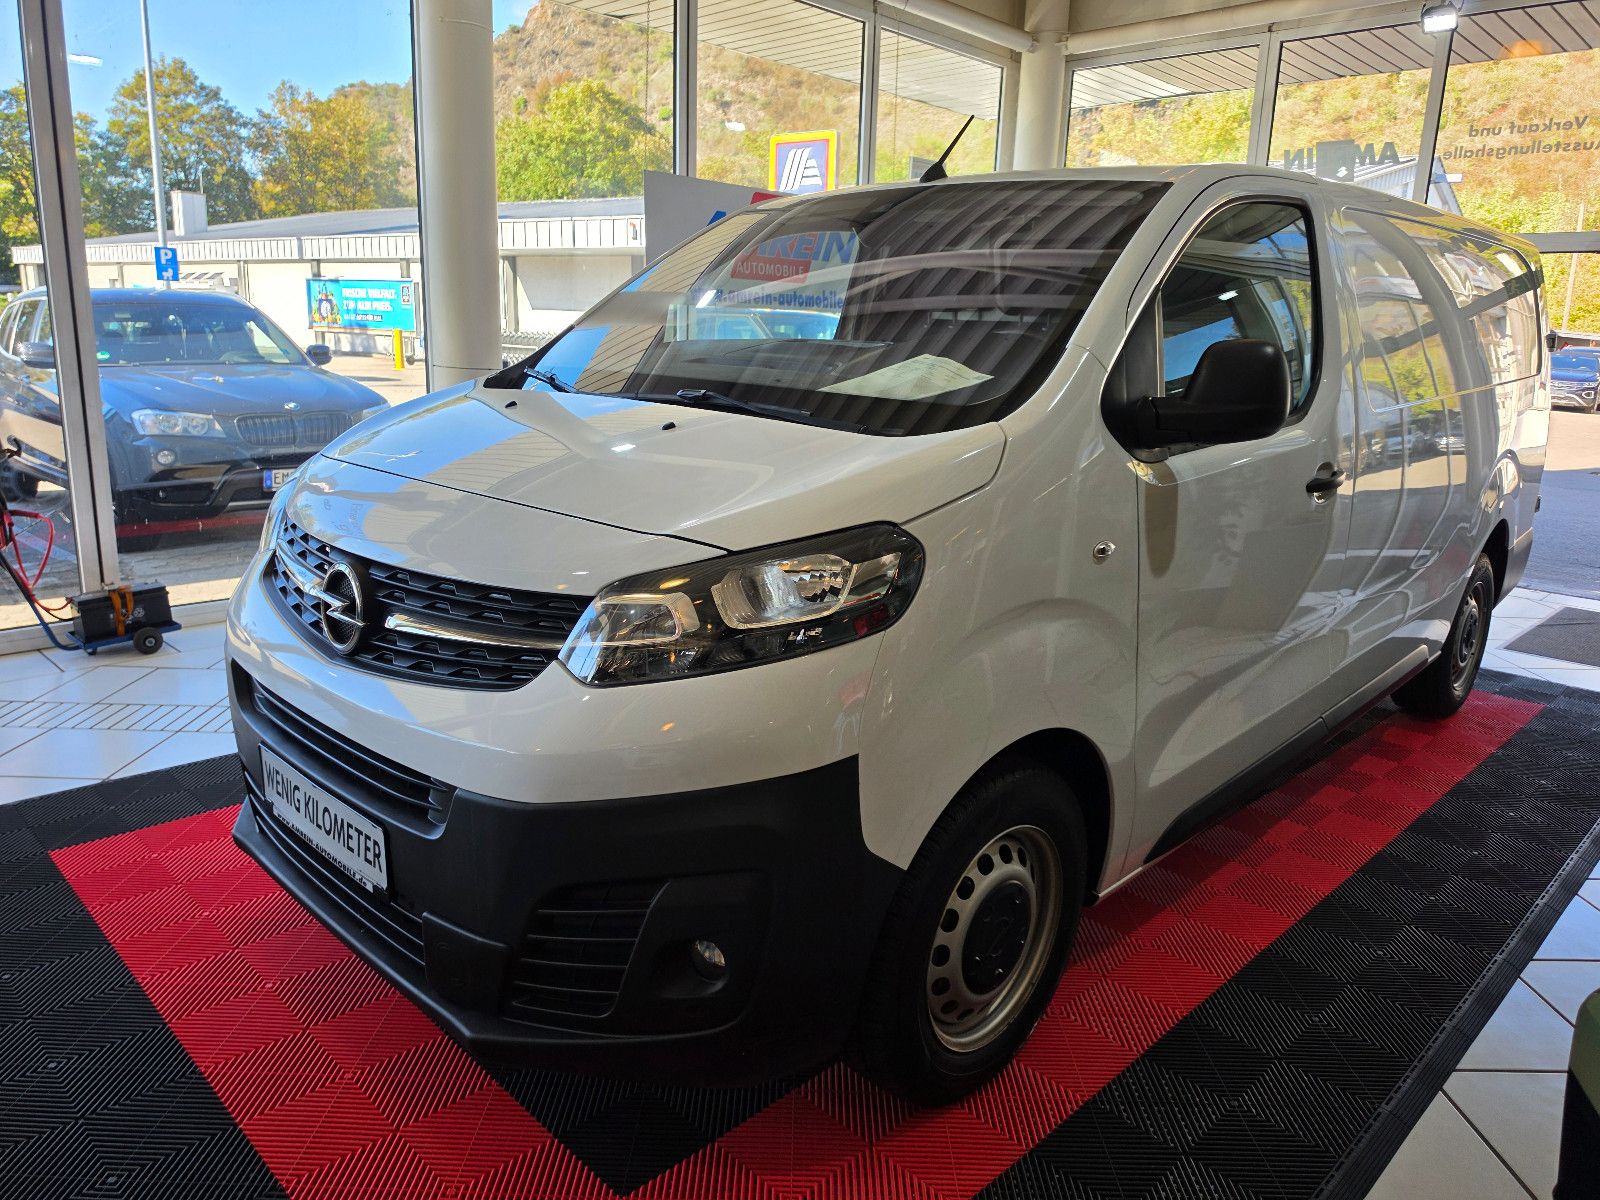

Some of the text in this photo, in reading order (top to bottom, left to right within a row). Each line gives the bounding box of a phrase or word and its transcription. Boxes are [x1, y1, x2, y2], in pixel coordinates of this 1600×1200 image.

[160, 248, 173, 265] P
[736, 261, 804, 277] AUTOMOBILE
[264, 760, 383, 874] WENIG KILOMETER
